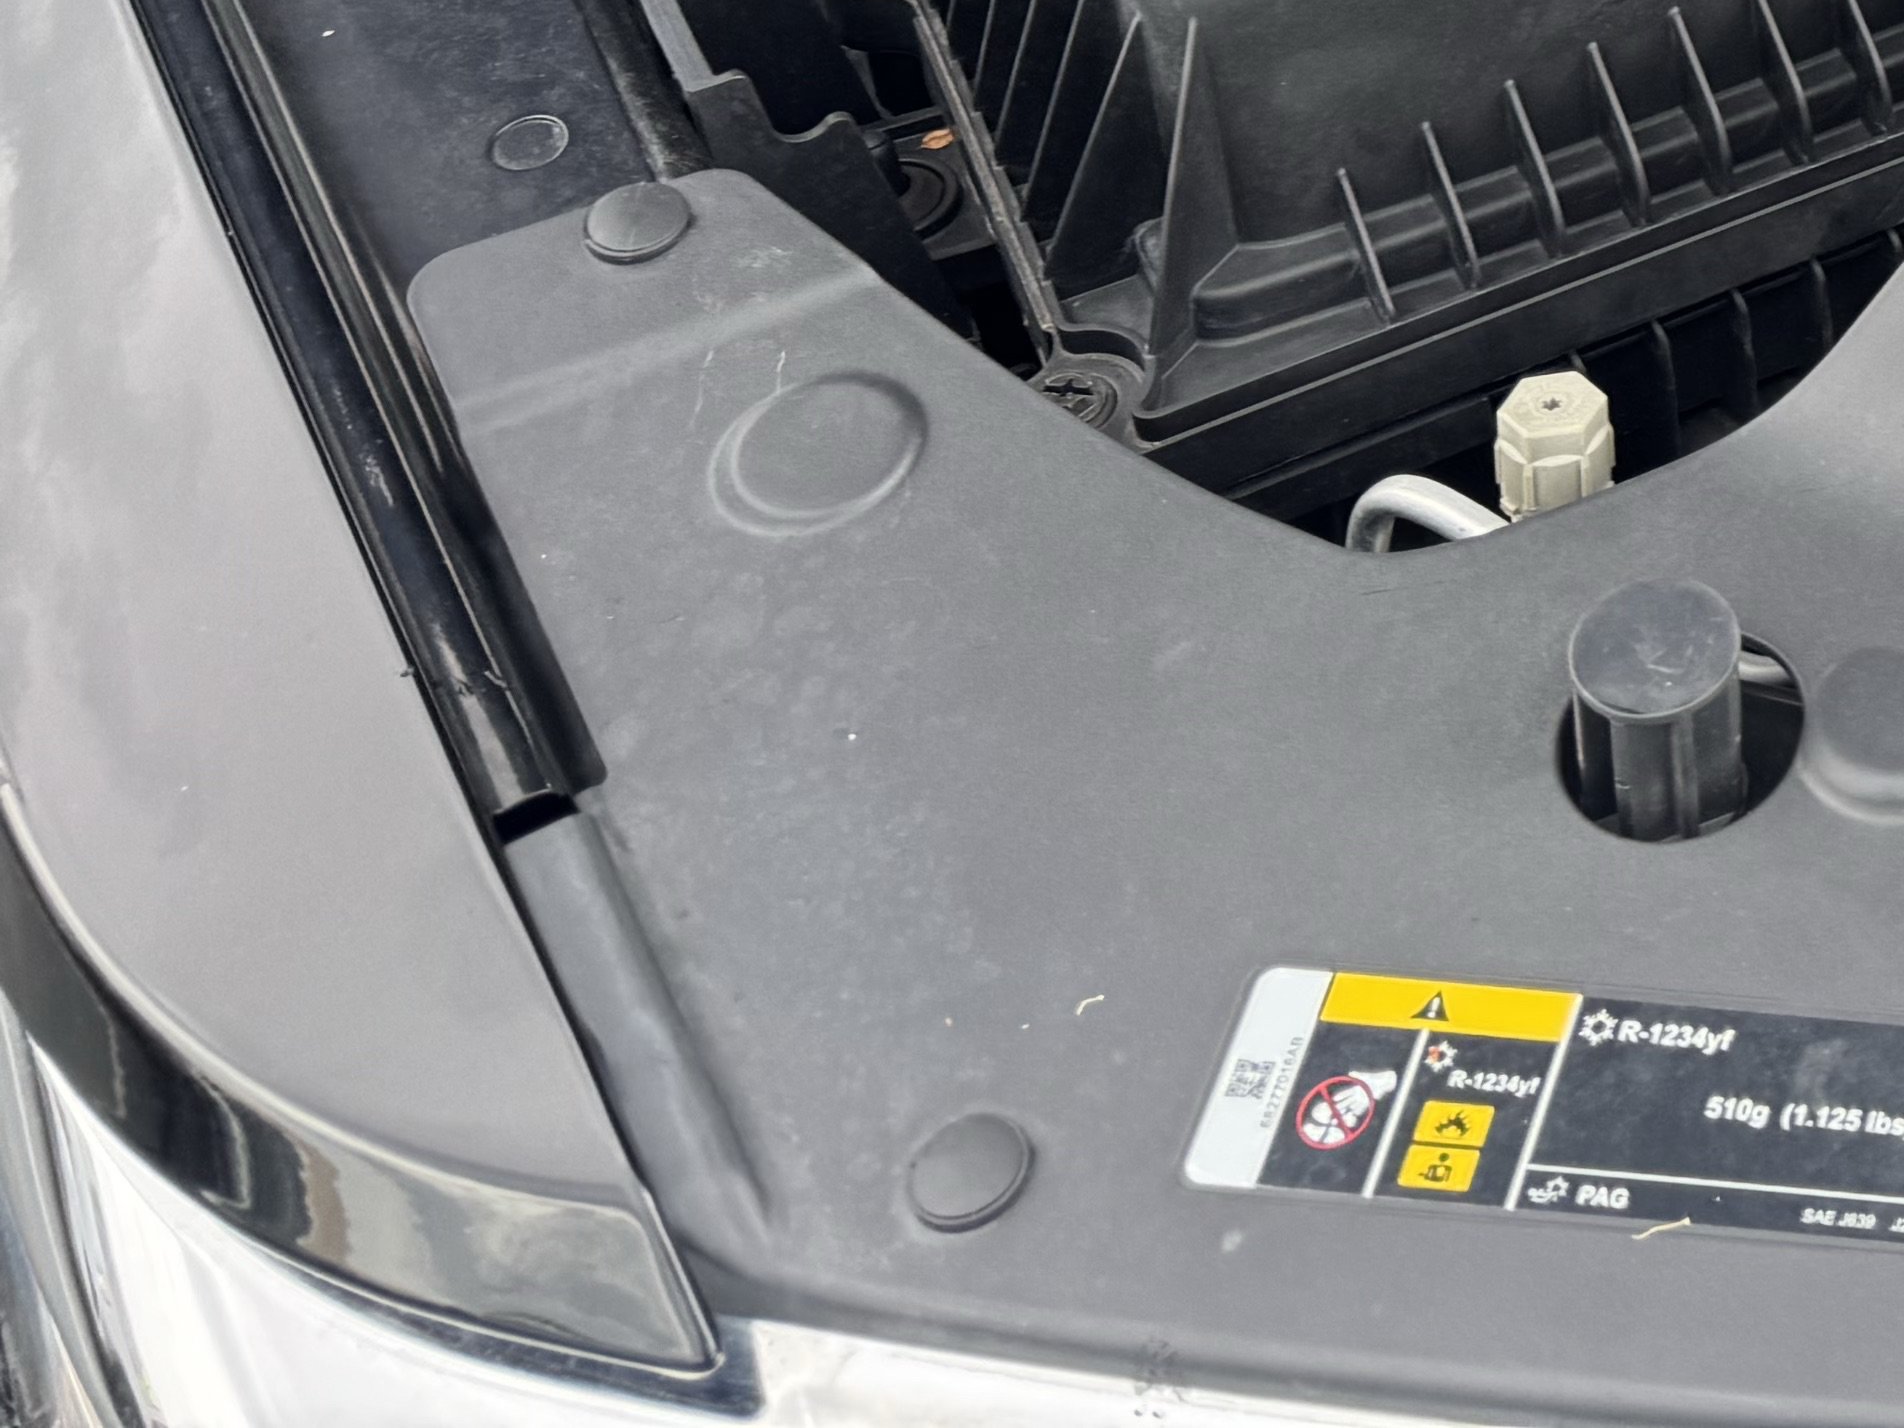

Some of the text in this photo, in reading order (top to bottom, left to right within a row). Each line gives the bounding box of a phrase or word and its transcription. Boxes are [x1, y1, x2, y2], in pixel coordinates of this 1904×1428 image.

[1616, 1017, 1738, 1056] R-1234yf
[1446, 1068, 1542, 1099] R-1234yf
[1702, 1094, 1772, 1130] 510g
[1779, 1101, 1863, 1133] (1.125
[1573, 1184, 1631, 1210] PAG
[1799, 1207, 1836, 1227] SAE
